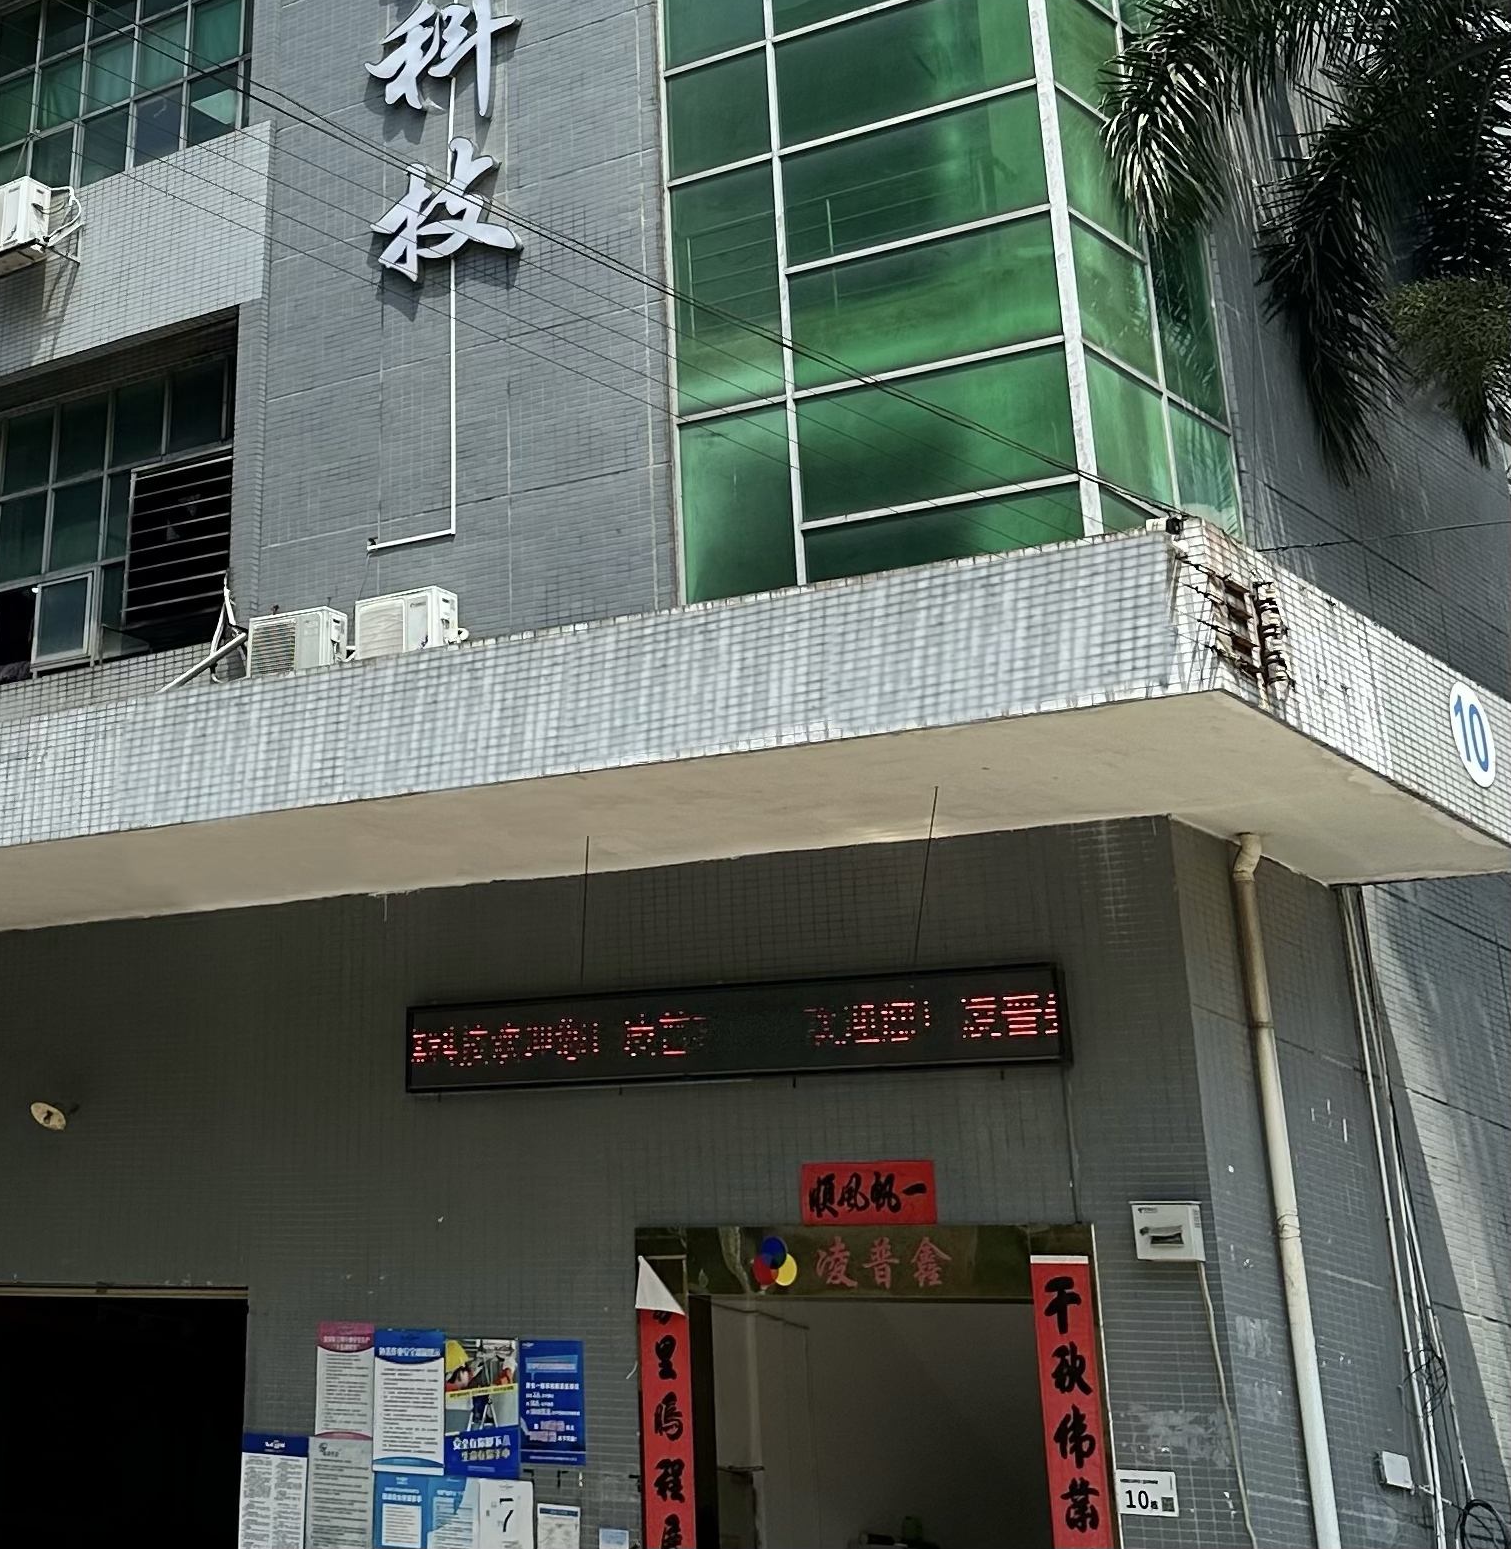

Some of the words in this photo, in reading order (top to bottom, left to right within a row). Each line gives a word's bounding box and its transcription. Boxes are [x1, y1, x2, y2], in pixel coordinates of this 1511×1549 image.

[1454, 694, 1489, 772] 10
[815, 1235, 953, 1289] 凌普鑫
